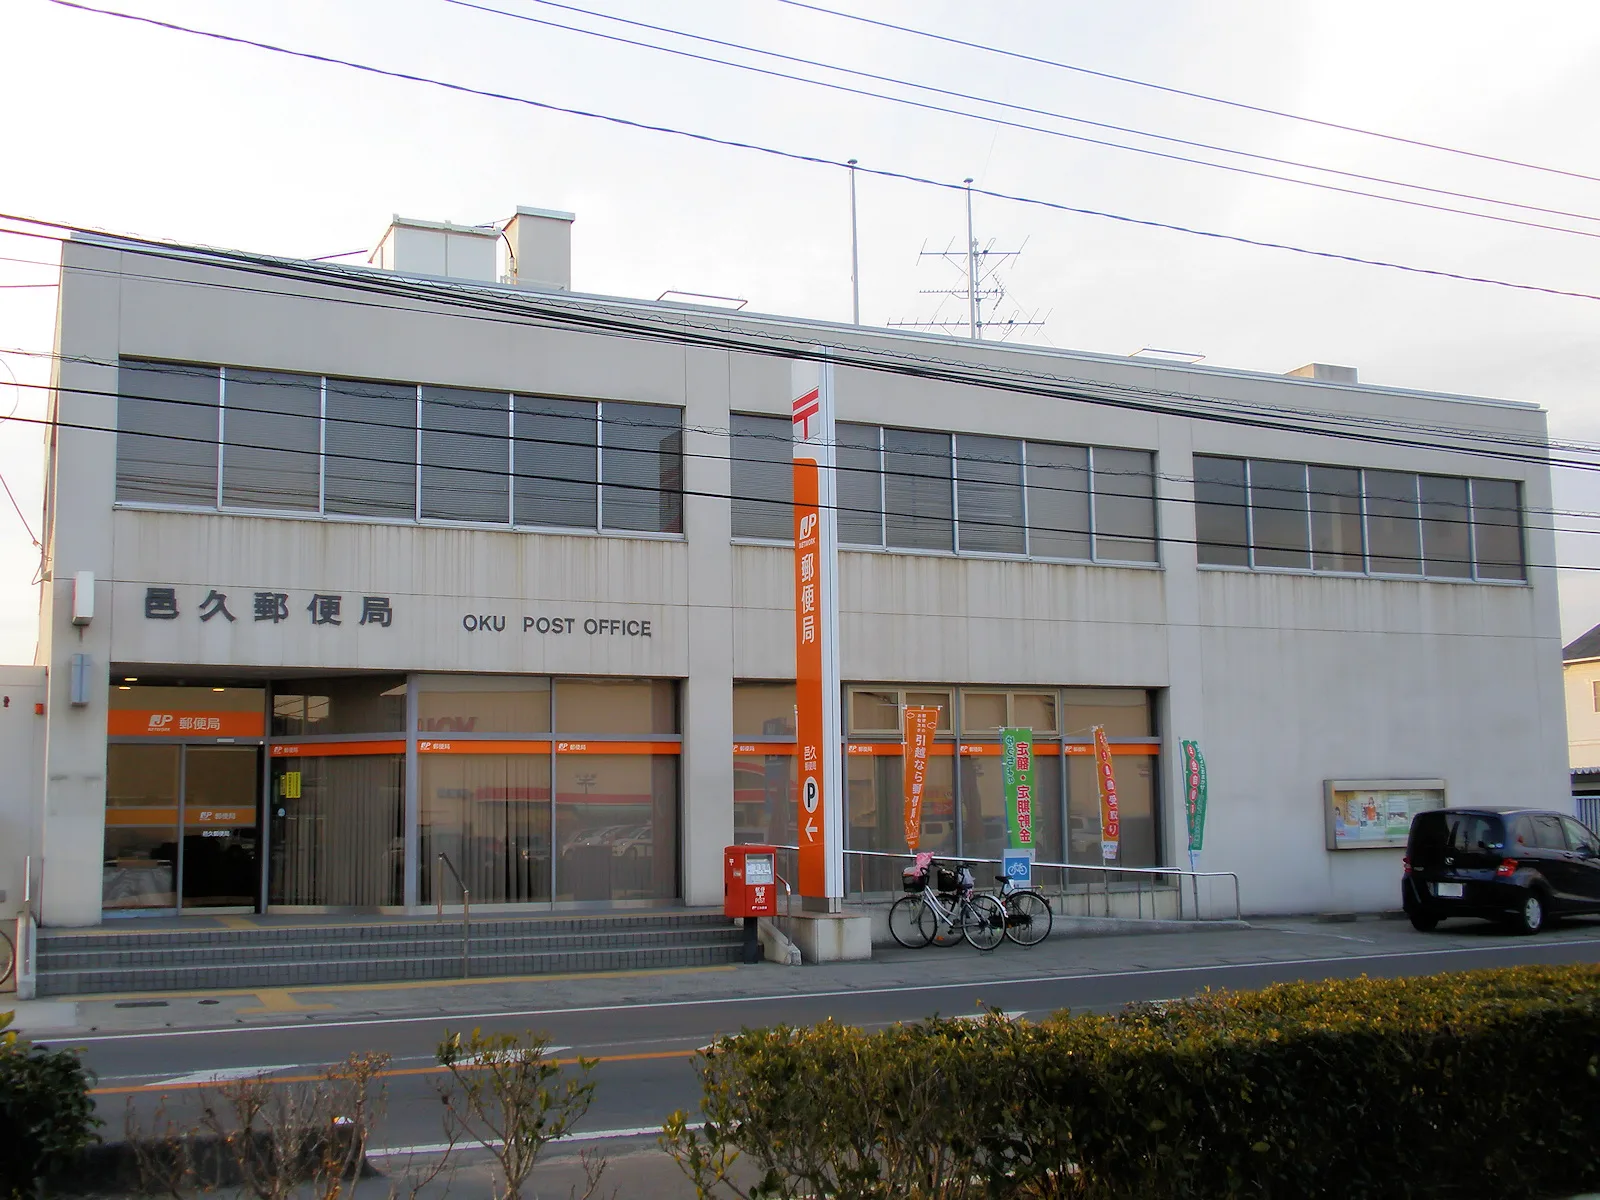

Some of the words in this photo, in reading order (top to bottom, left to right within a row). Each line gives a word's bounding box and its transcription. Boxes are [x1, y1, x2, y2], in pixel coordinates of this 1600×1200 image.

[144, 586, 394, 627] 邑久郵便局
[801, 553, 814, 644] 郵便局
[463, 614, 506, 632] OKU
[523, 615, 575, 634] POST
[583, 617, 652, 638] OFFICE
[179, 717, 220, 731] 郵便局
[807, 783, 815, 808] P
